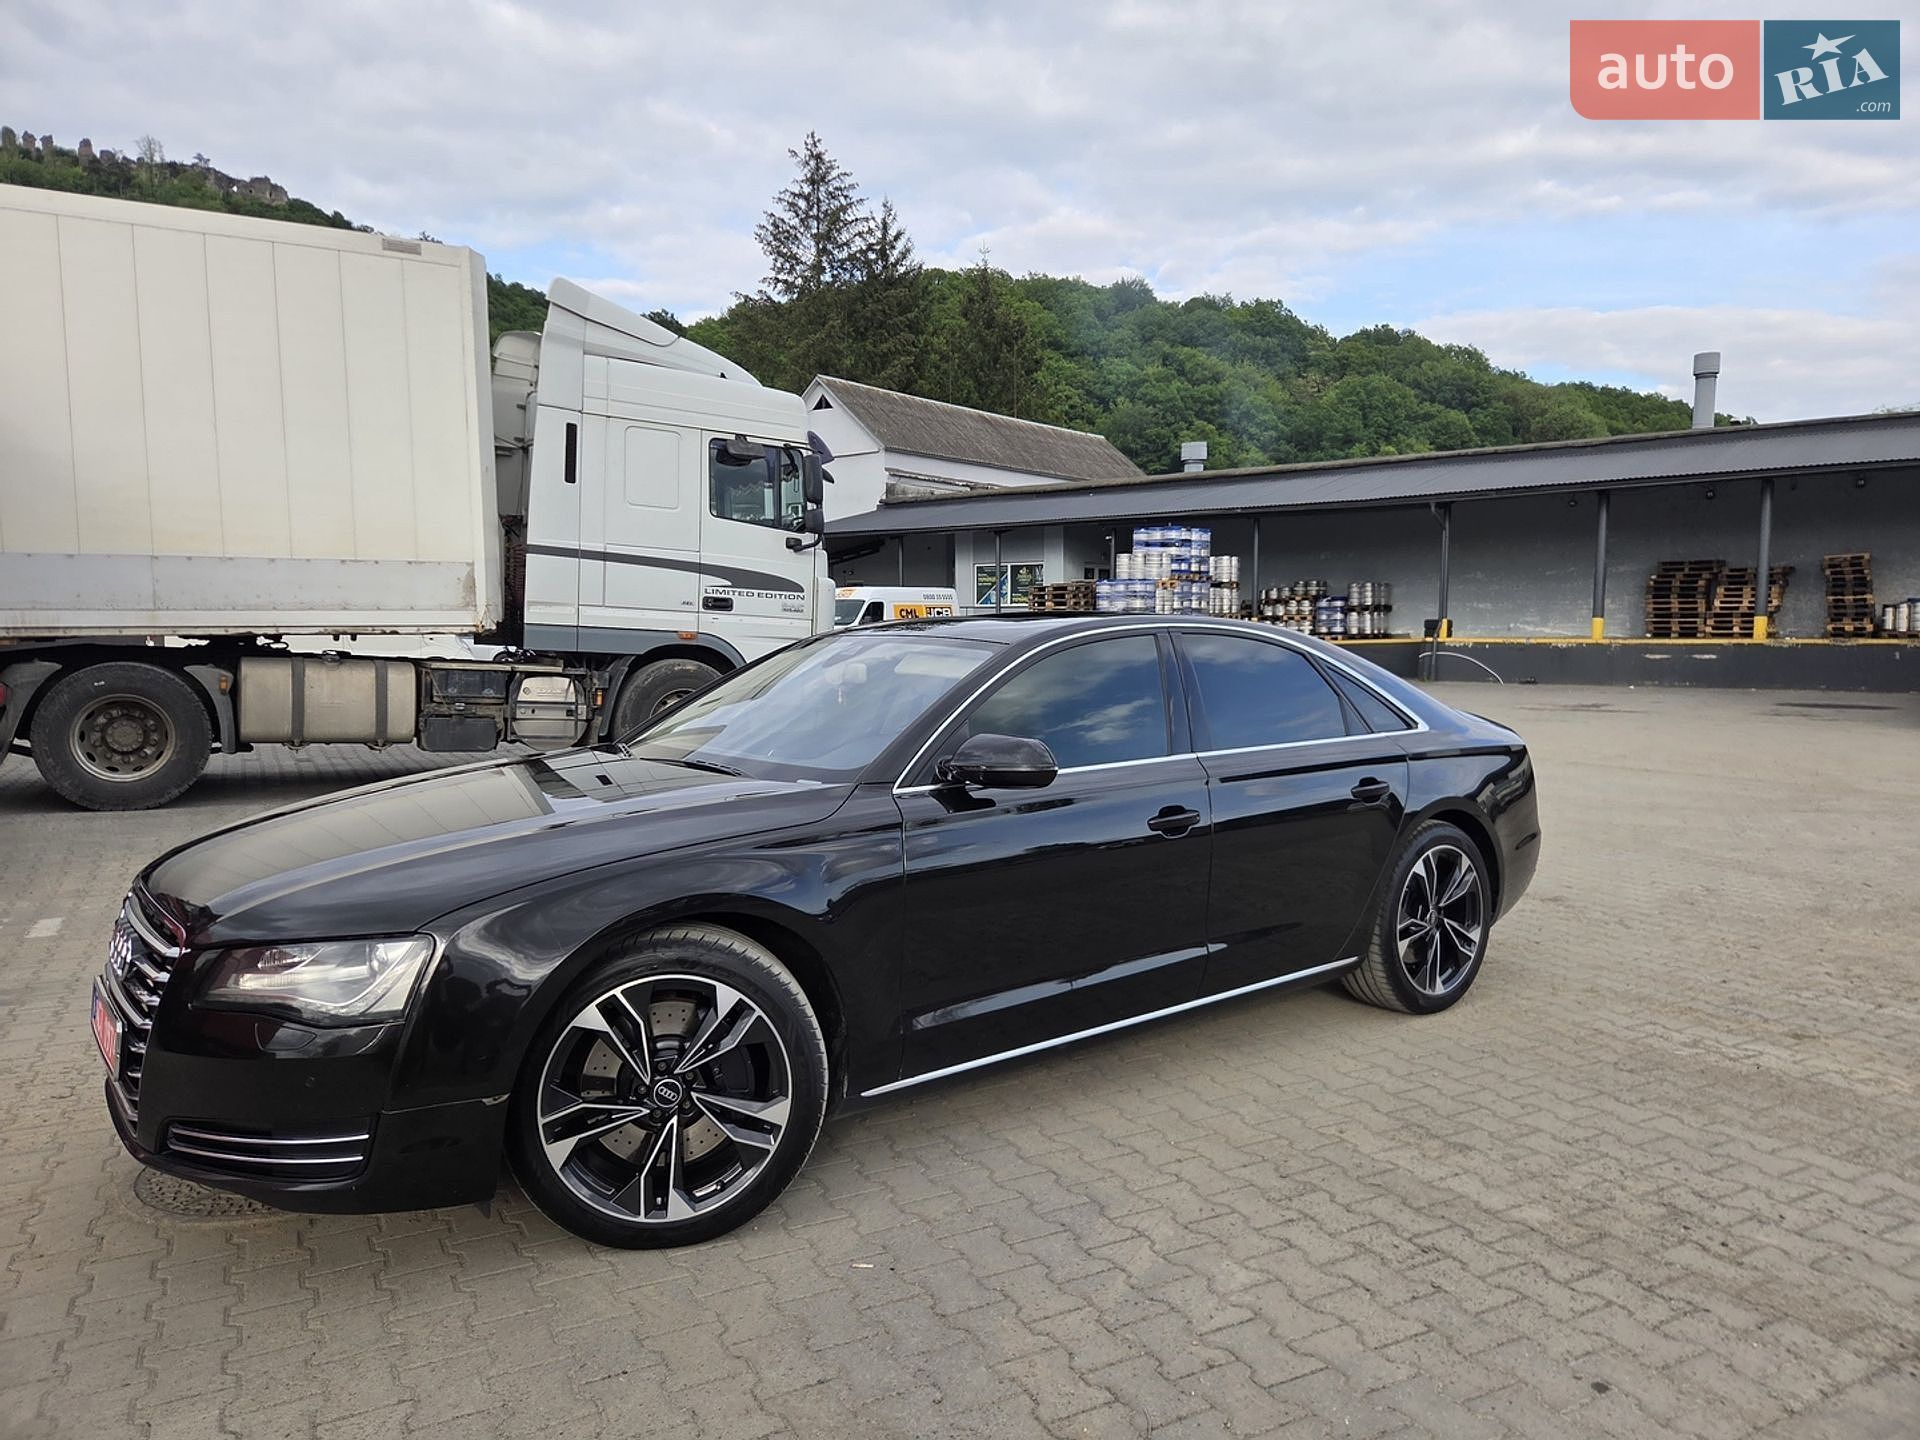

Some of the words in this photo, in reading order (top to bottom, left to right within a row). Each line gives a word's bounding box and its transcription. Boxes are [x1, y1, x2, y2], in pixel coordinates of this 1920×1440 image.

[704, 588, 754, 598] LIMITED
[757, 592, 806, 601] EDITION
[899, 607, 919, 618] CML
[927, 607, 952, 618] JCB
